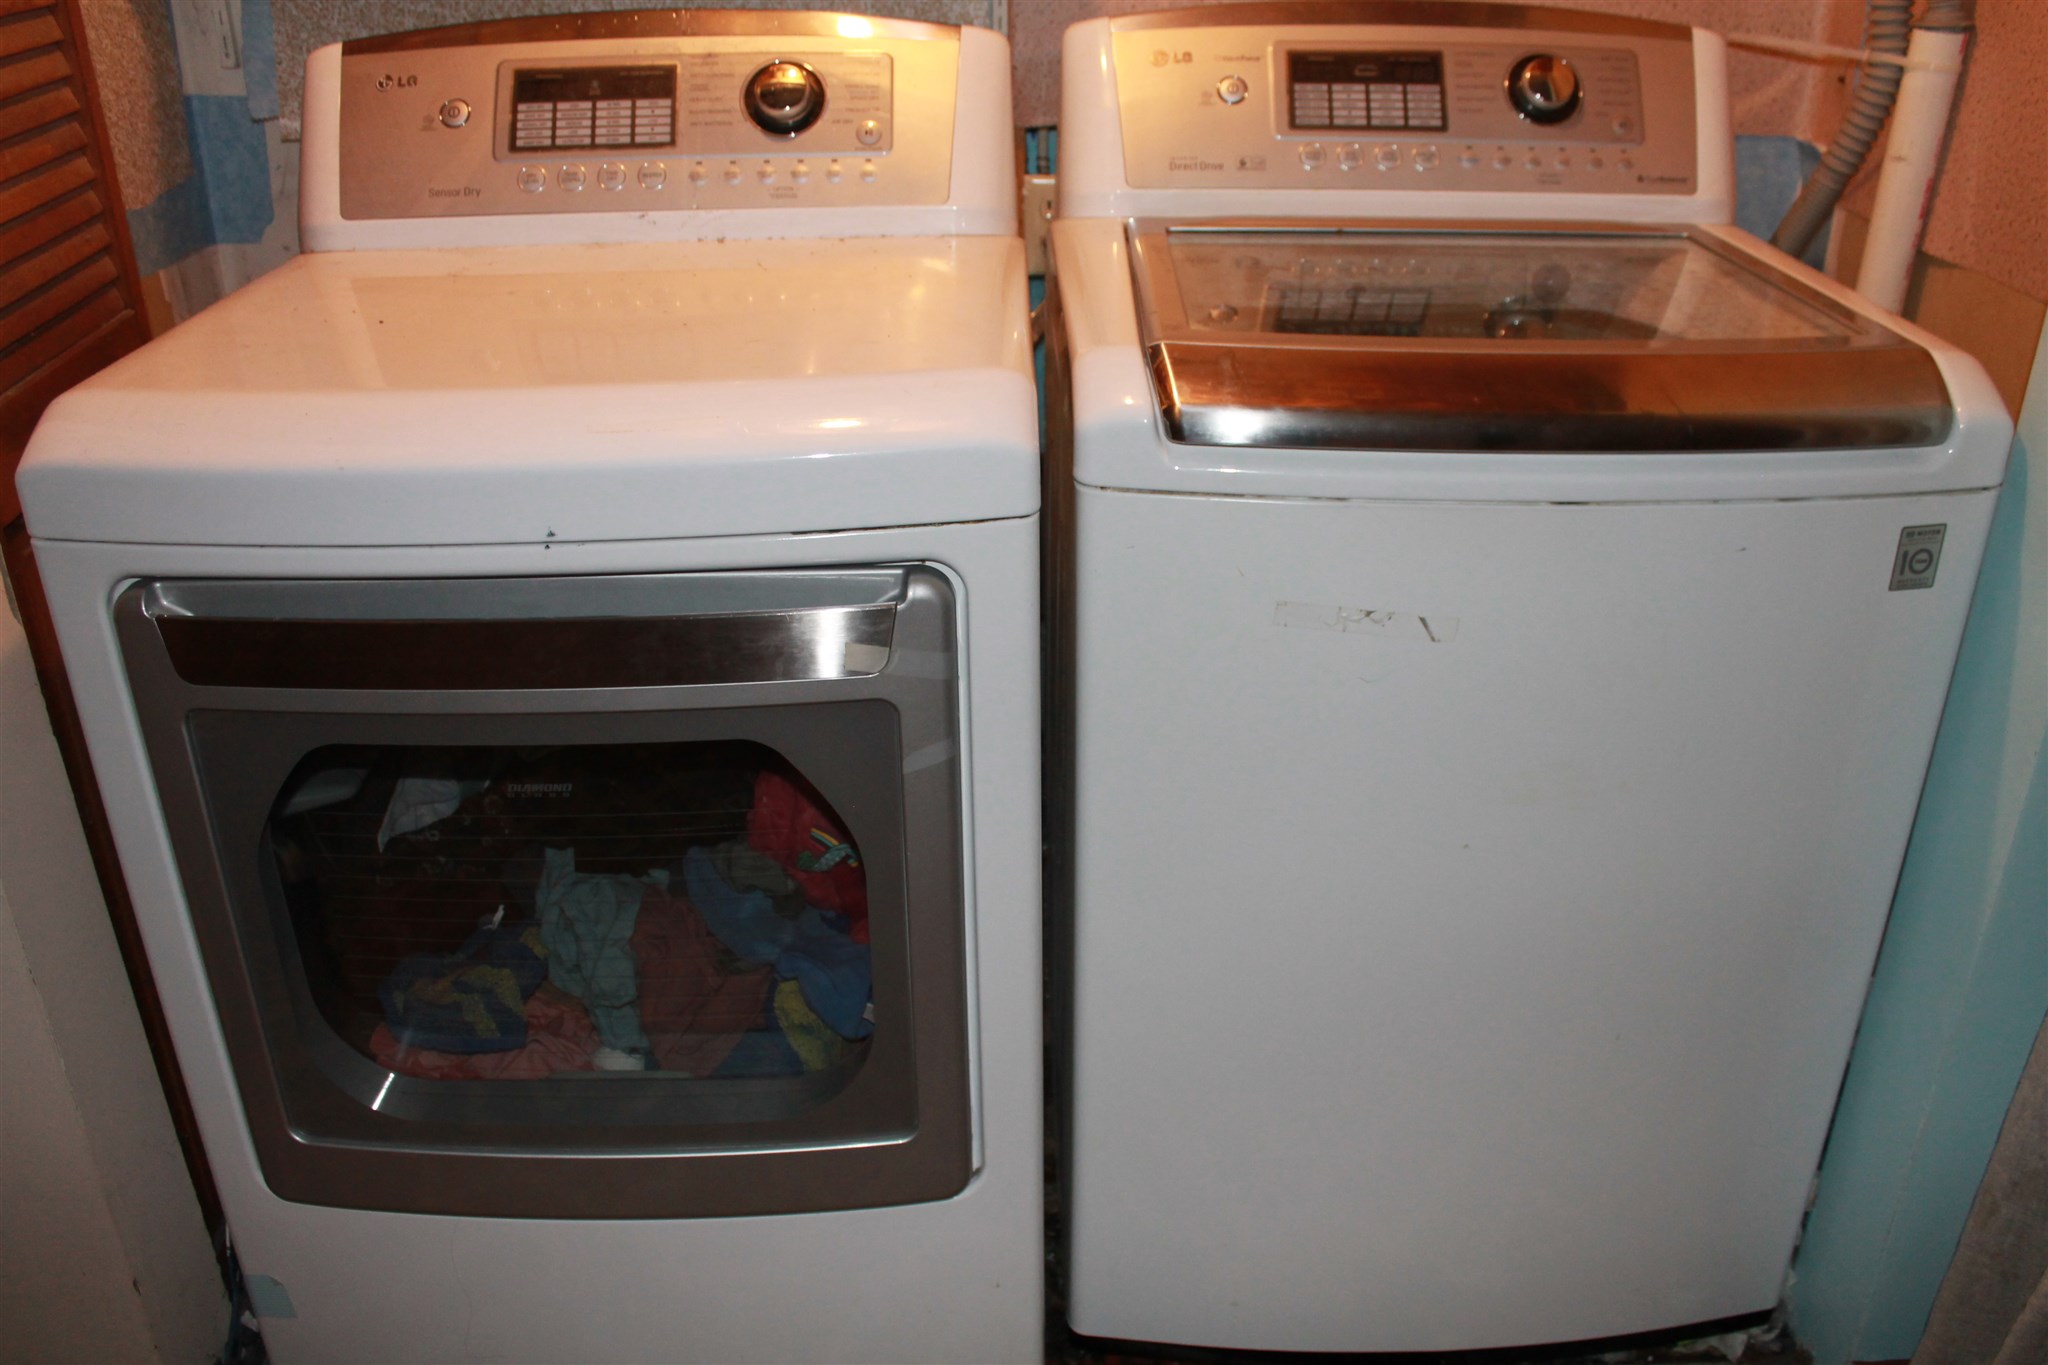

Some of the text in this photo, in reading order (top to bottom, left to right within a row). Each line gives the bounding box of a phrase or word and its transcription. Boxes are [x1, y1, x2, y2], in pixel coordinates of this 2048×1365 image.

[1173, 51, 1193, 64] LG
[397, 75, 418, 89] LG
[428, 186, 481, 198] Sensor Dry
[508, 783, 573, 792] DIAMOND
